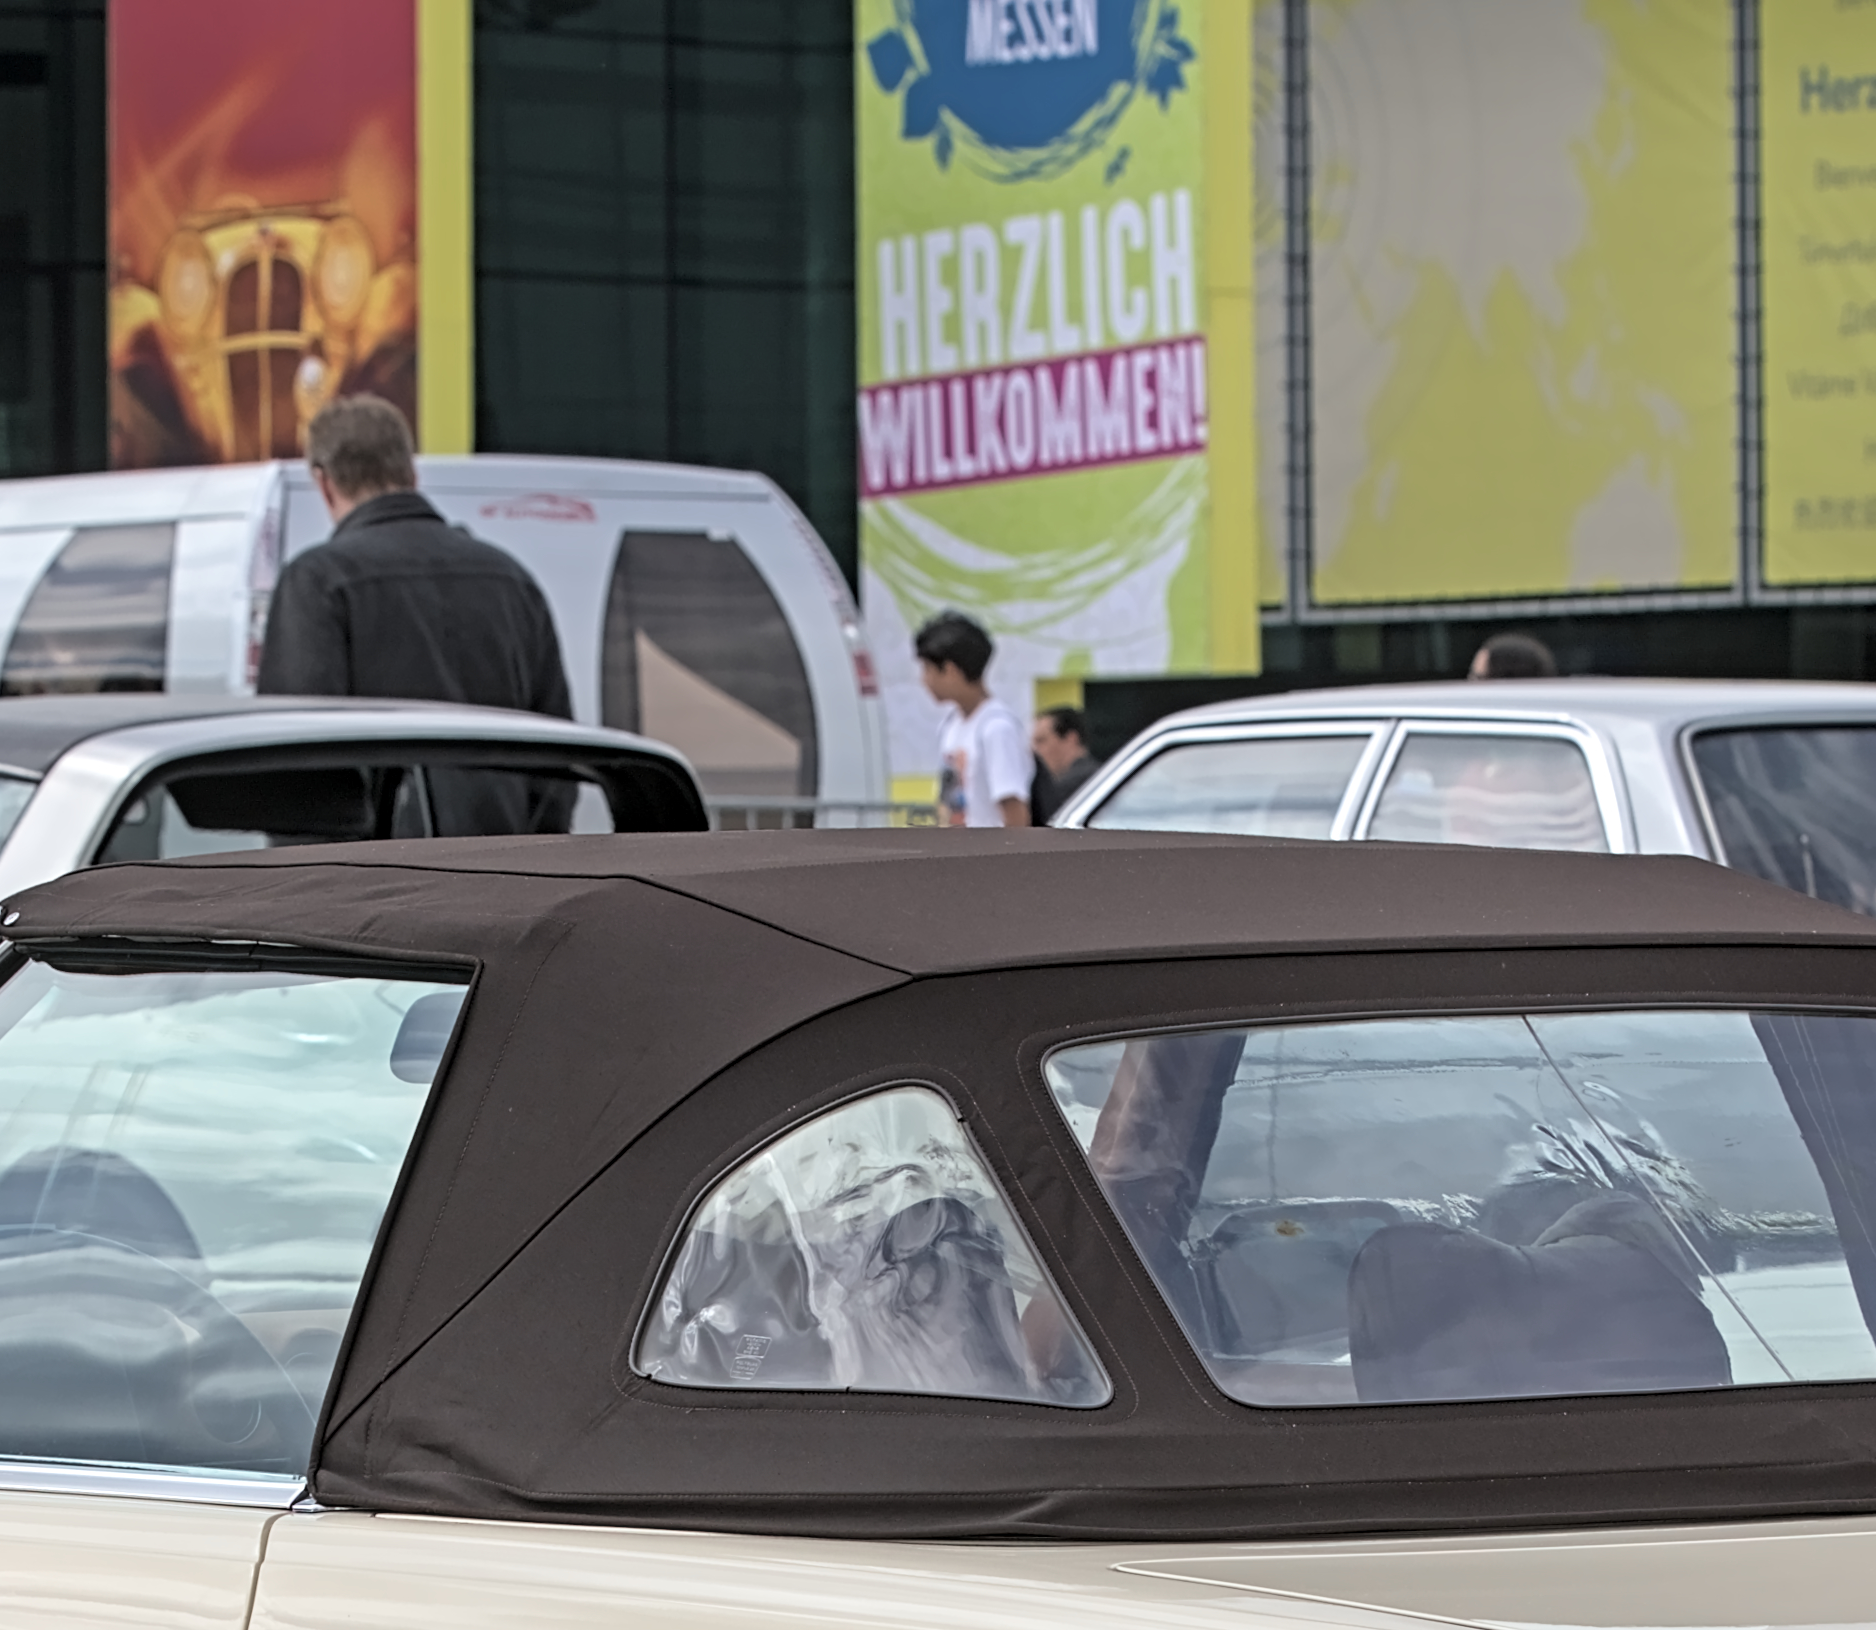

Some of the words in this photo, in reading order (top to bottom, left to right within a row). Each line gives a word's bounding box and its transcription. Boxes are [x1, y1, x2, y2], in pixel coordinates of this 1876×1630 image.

[965, 0, 1098, 66] MESSEN
[875, 187, 1196, 380] HERZLICH
[859, 340, 1208, 491] WILLKOMMEN!
